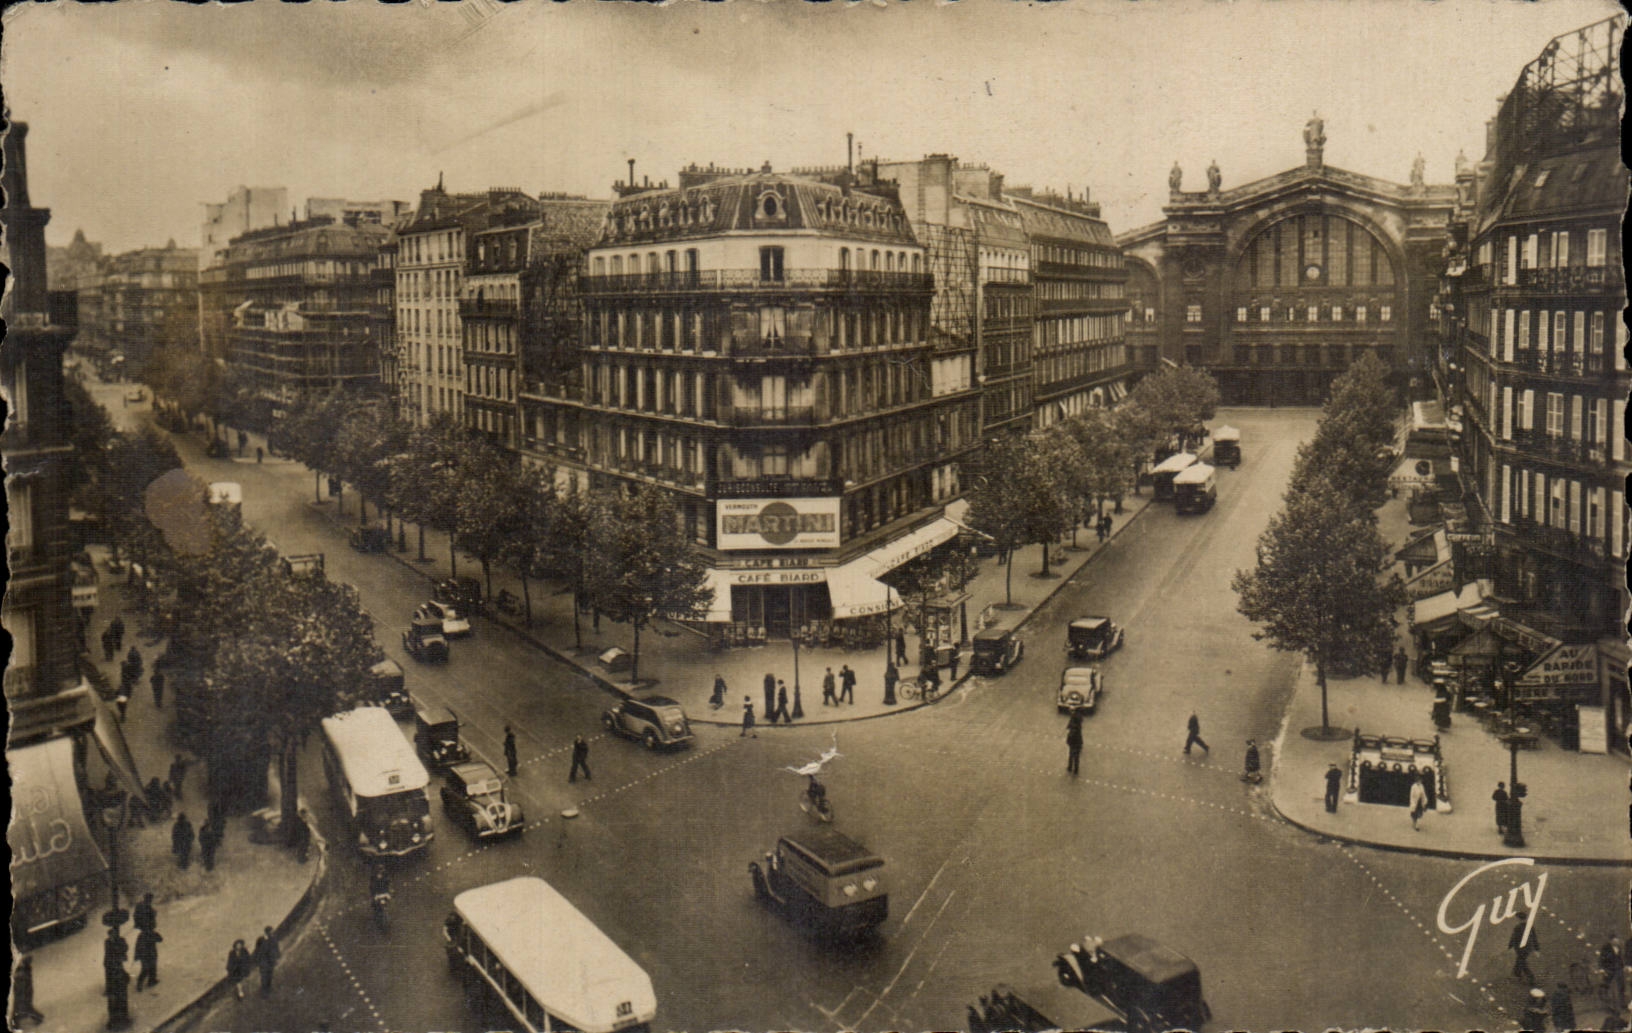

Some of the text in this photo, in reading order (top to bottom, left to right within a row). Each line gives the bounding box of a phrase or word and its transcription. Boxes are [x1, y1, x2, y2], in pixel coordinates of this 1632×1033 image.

[724, 503, 759, 511] VERMOUTH
[725, 513, 834, 535] MARTINI
[738, 572, 819, 583] CAFÉ BIARD
[1560, 648, 1578, 659] AU
